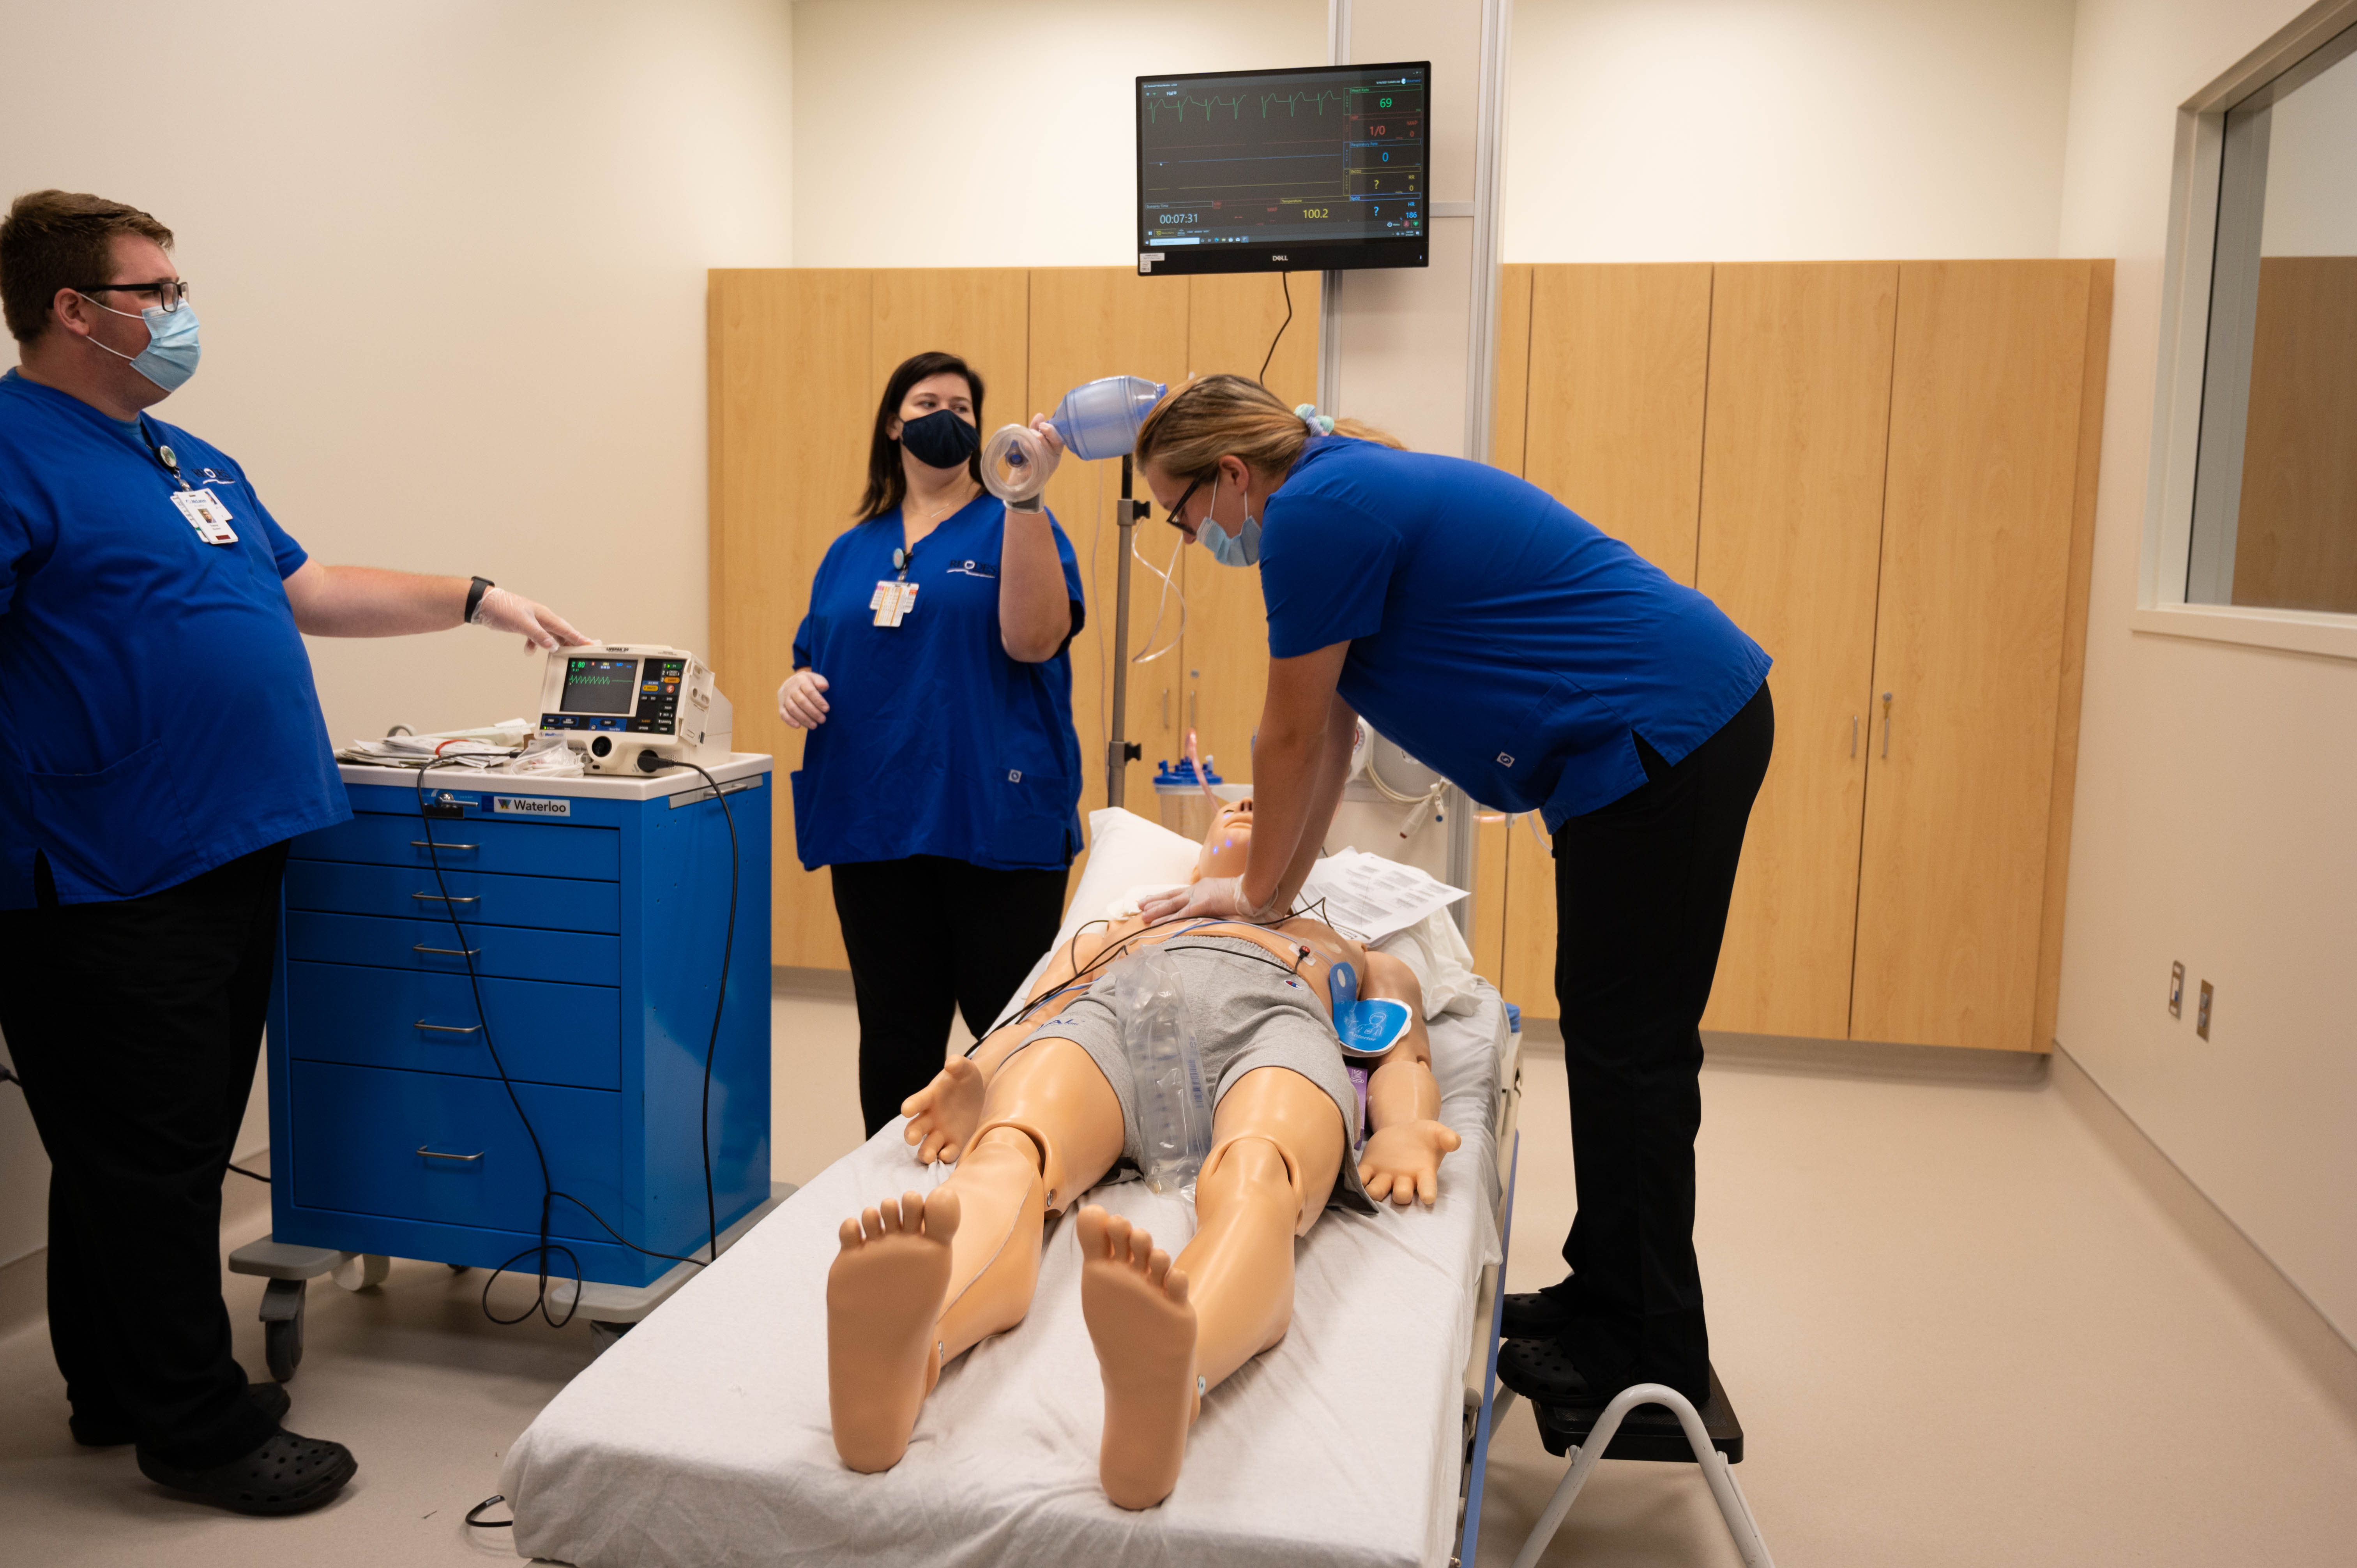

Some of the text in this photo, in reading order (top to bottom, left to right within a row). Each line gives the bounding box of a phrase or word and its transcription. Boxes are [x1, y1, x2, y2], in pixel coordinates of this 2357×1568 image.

[1380, 98, 1392, 108] 69
[1369, 125, 1385, 136] 1/0
[1382, 152, 1389, 162] 0
[1374, 180, 1379, 189] ?
[1303, 209, 1328, 219] 100.2
[1374, 206, 1380, 216] ?
[1160, 214, 1198, 224] 00:07:31
[950, 560, 996, 572] RHODES
[514, 800, 566, 812] Waterloo
[1349, 1032, 1376, 1041] Anterior
